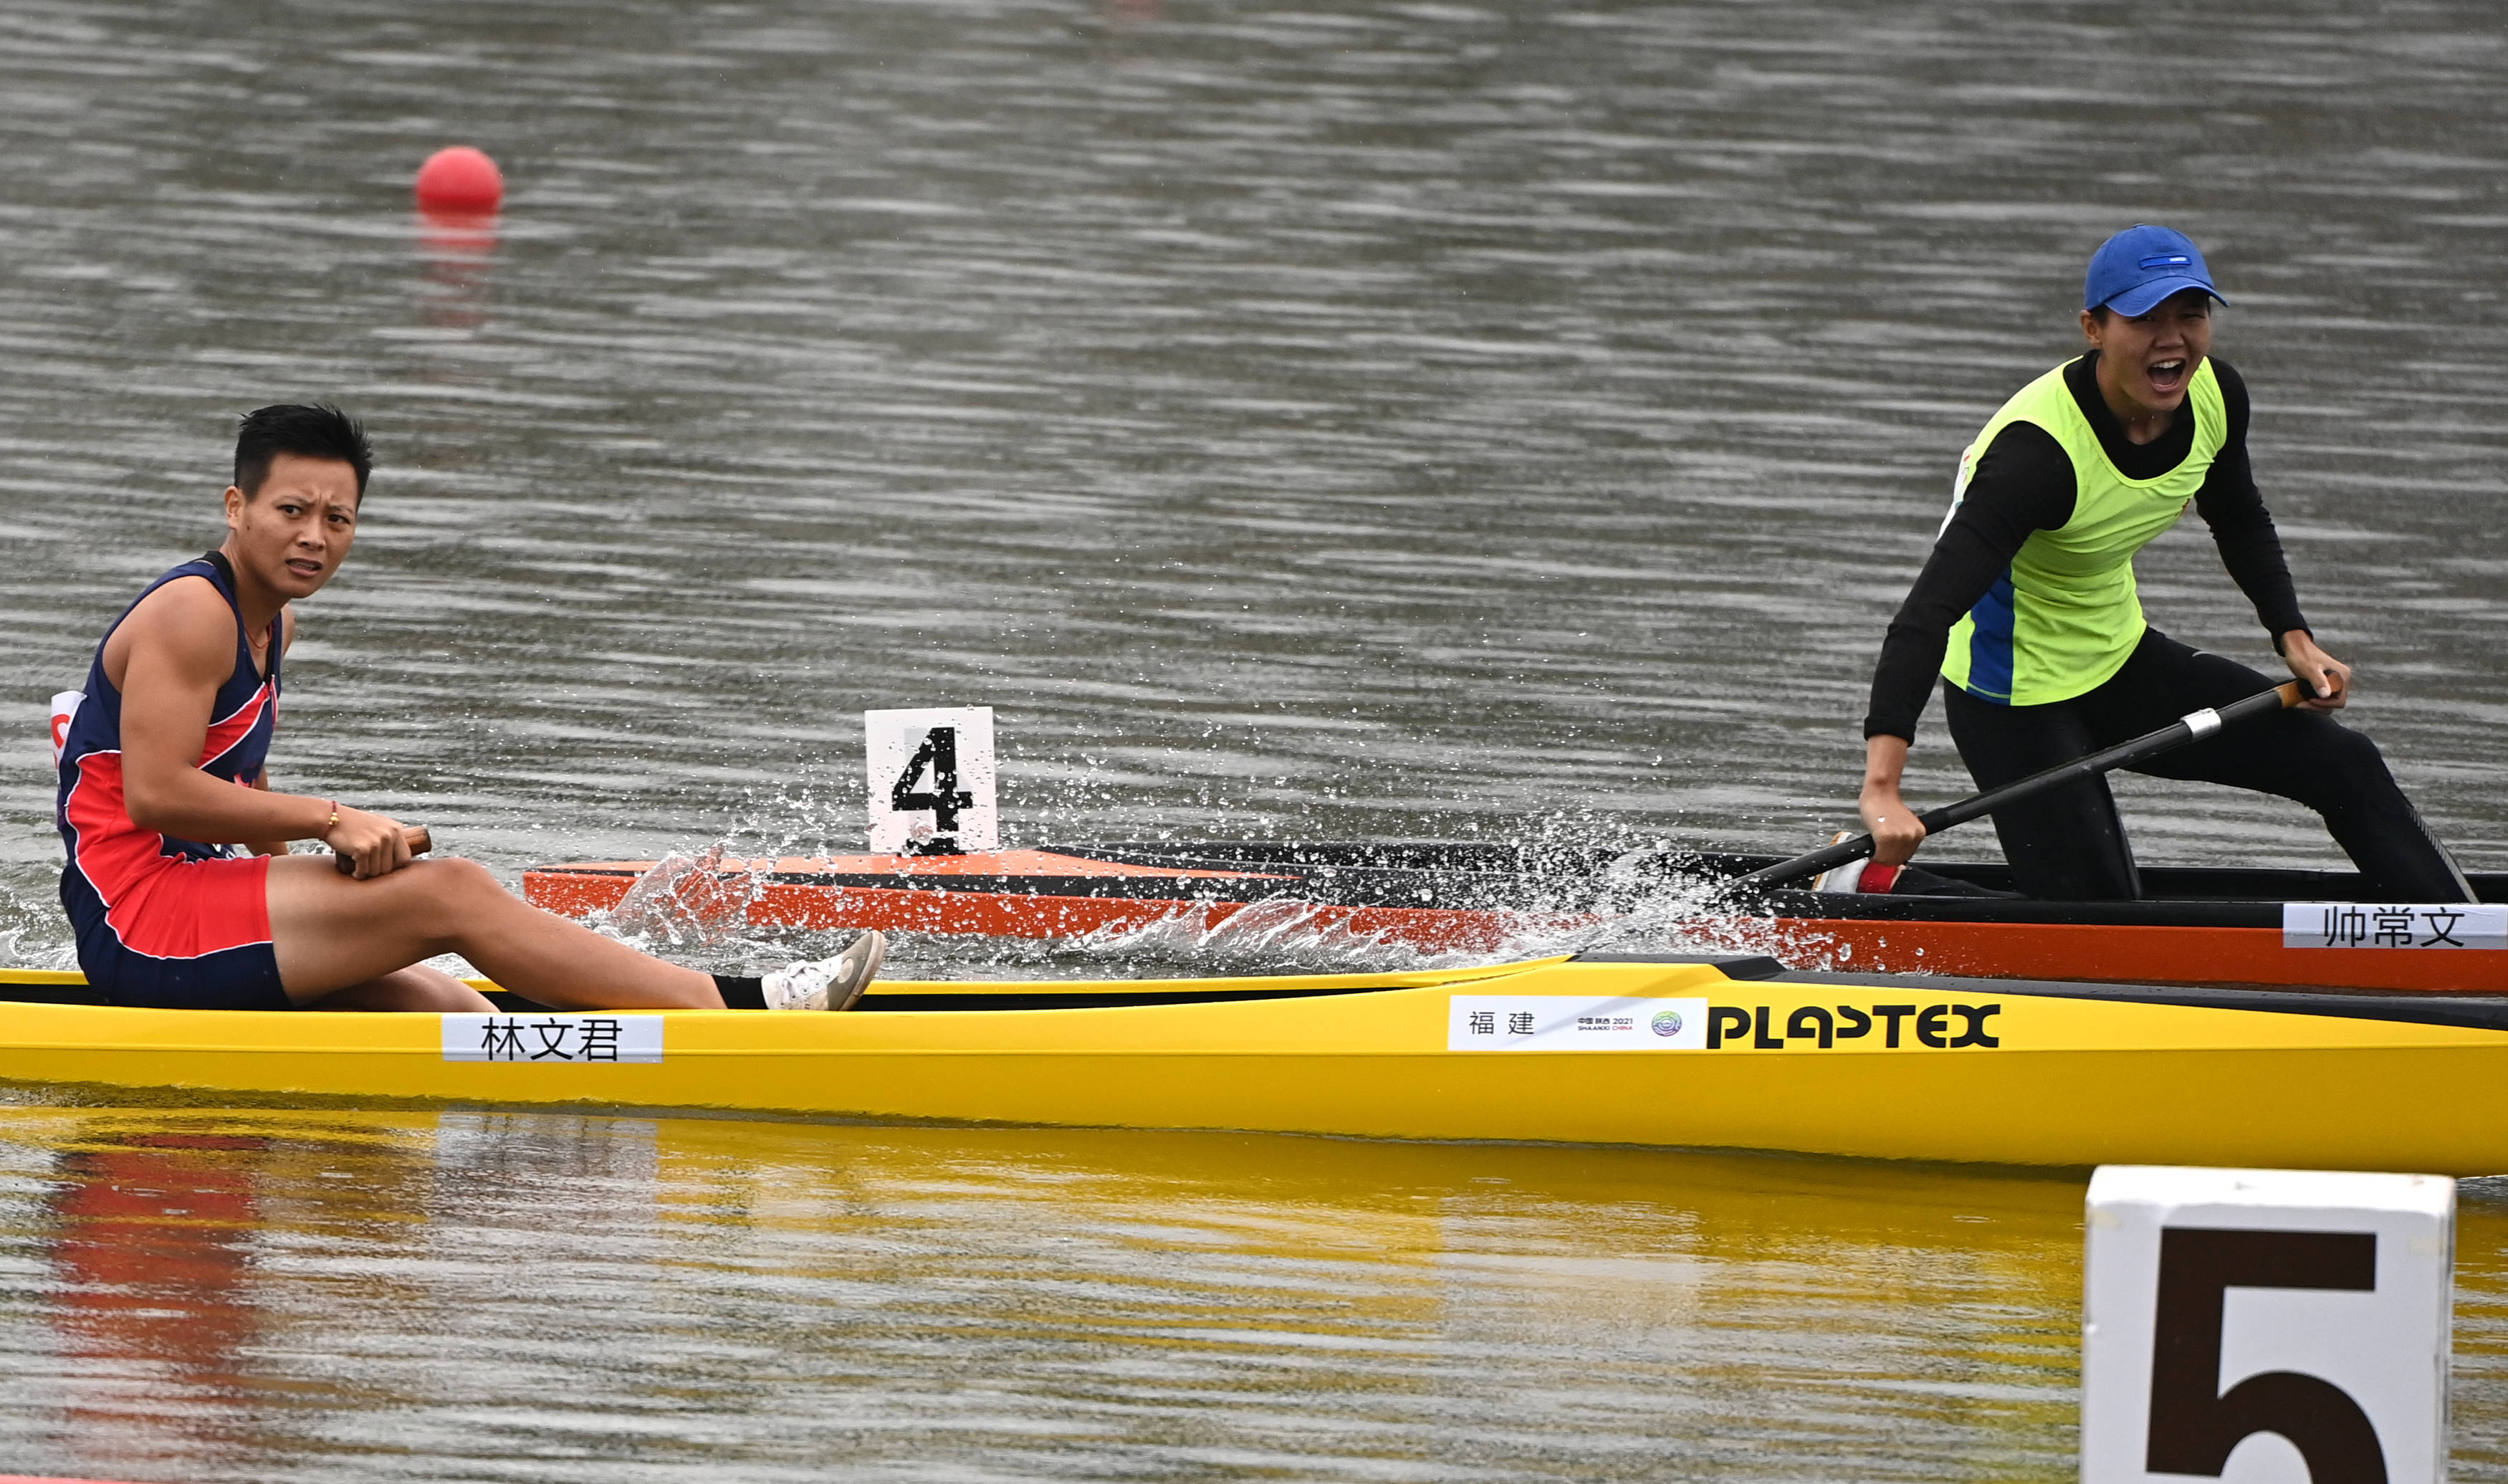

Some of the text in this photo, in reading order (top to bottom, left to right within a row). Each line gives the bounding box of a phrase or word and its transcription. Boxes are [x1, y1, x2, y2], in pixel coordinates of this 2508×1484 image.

[892, 727, 974, 832] 4
[2324, 906, 2465, 947] 帅常文
[481, 1017, 623, 1062] 林文君
[1706, 1004, 2001, 1049] PLASTEX
[2146, 1226, 2390, 1484] 5
